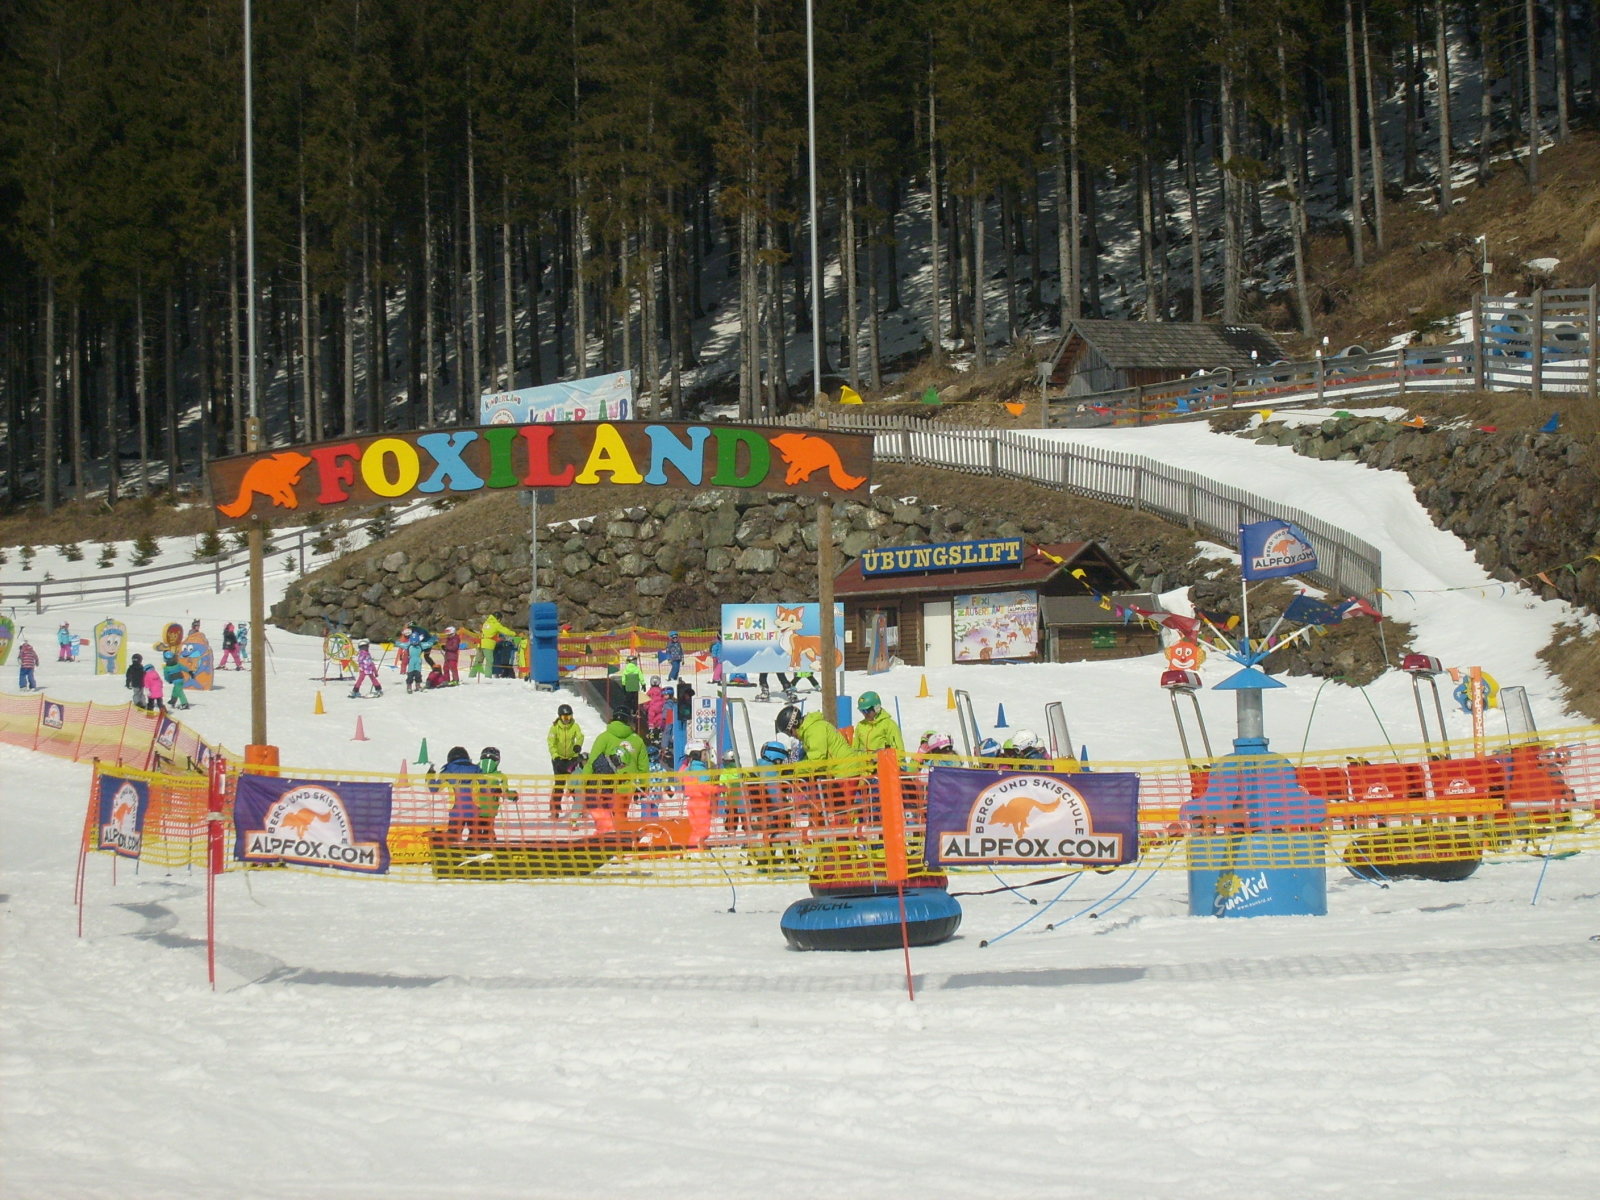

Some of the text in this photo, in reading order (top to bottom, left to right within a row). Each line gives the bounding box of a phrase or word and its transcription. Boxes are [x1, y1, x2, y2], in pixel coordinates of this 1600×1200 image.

[529, 399, 628, 423] KINDERAND
[310, 422, 772, 504] FOXILAND
[862, 542, 1020, 572] ÜBUNGSLIFT
[1255, 551, 1314, 568] ALPFOXCOM
[723, 631, 779, 641] ZAUBERLIFT
[736, 617, 766, 630] FOXI
[290, 792, 311, 804] UND
[313, 792, 348, 845] SKISCHULE
[999, 779, 1028, 793] UND
[1033, 779, 1084, 835] SKISCHULE
[250, 836, 374, 865] ALPFOX.COM
[944, 837, 1116, 858] ALPFOX.COM
